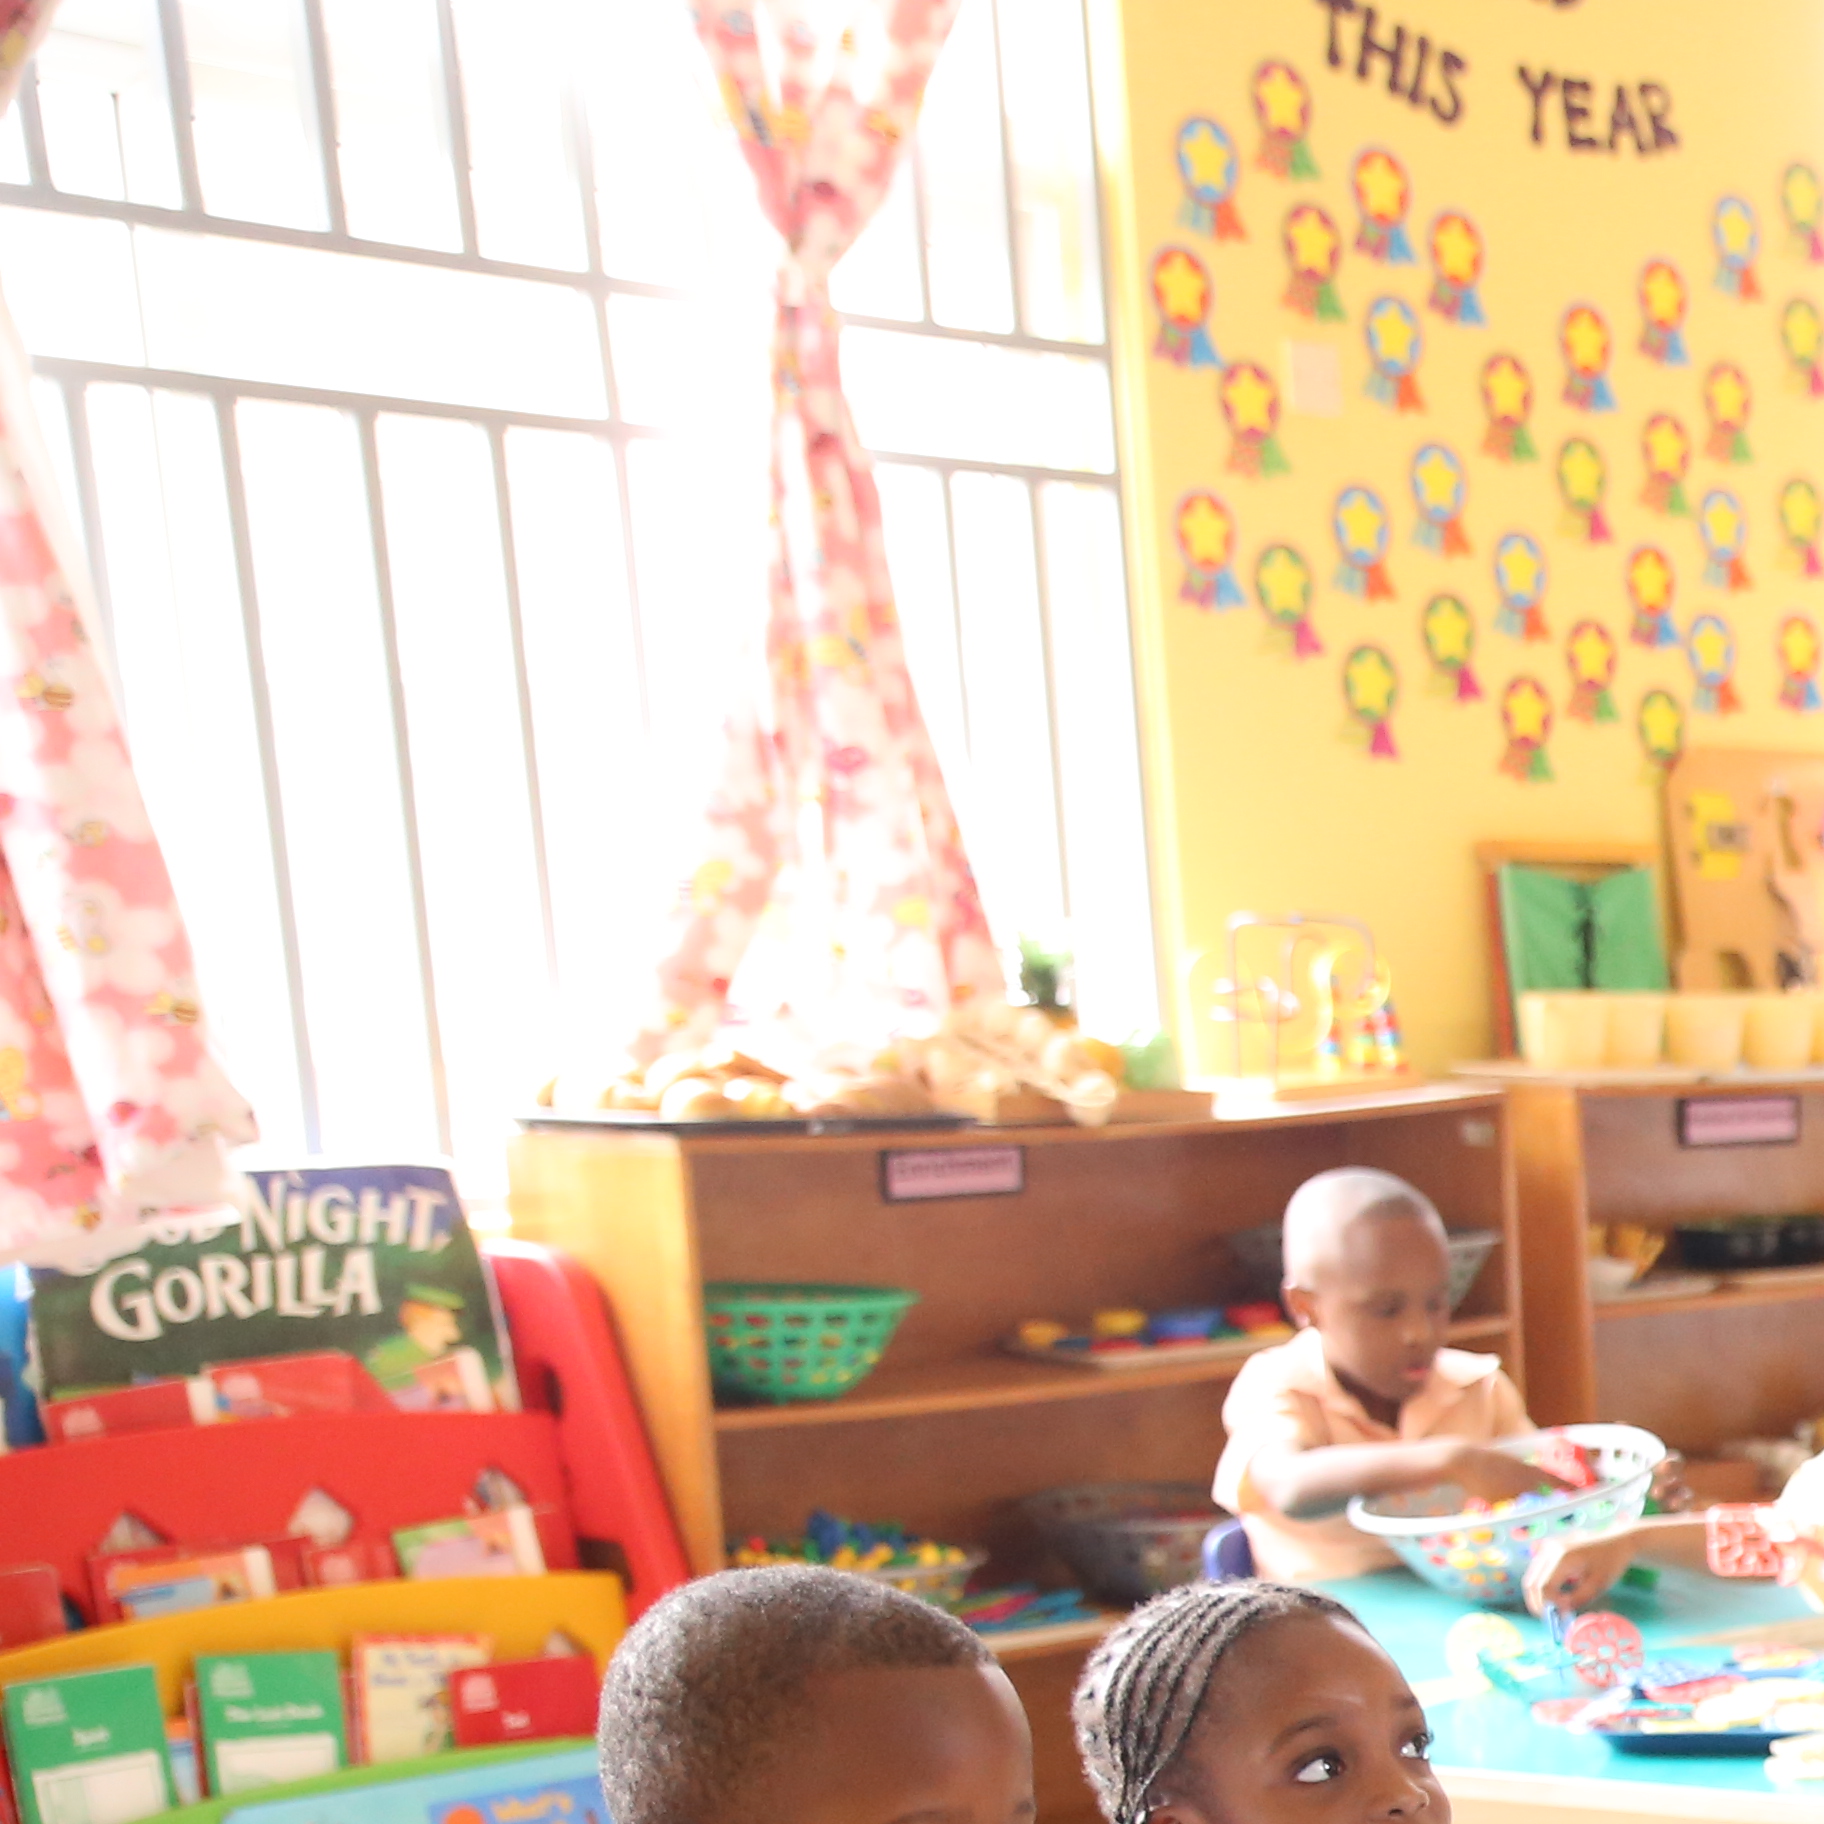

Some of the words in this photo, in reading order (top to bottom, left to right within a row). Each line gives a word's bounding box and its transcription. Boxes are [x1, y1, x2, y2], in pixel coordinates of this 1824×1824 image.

[1318, 0, 1466, 124] THIS
[1518, 65, 1679, 154] YEAR
[90, 1244, 384, 1342] GORILLA
